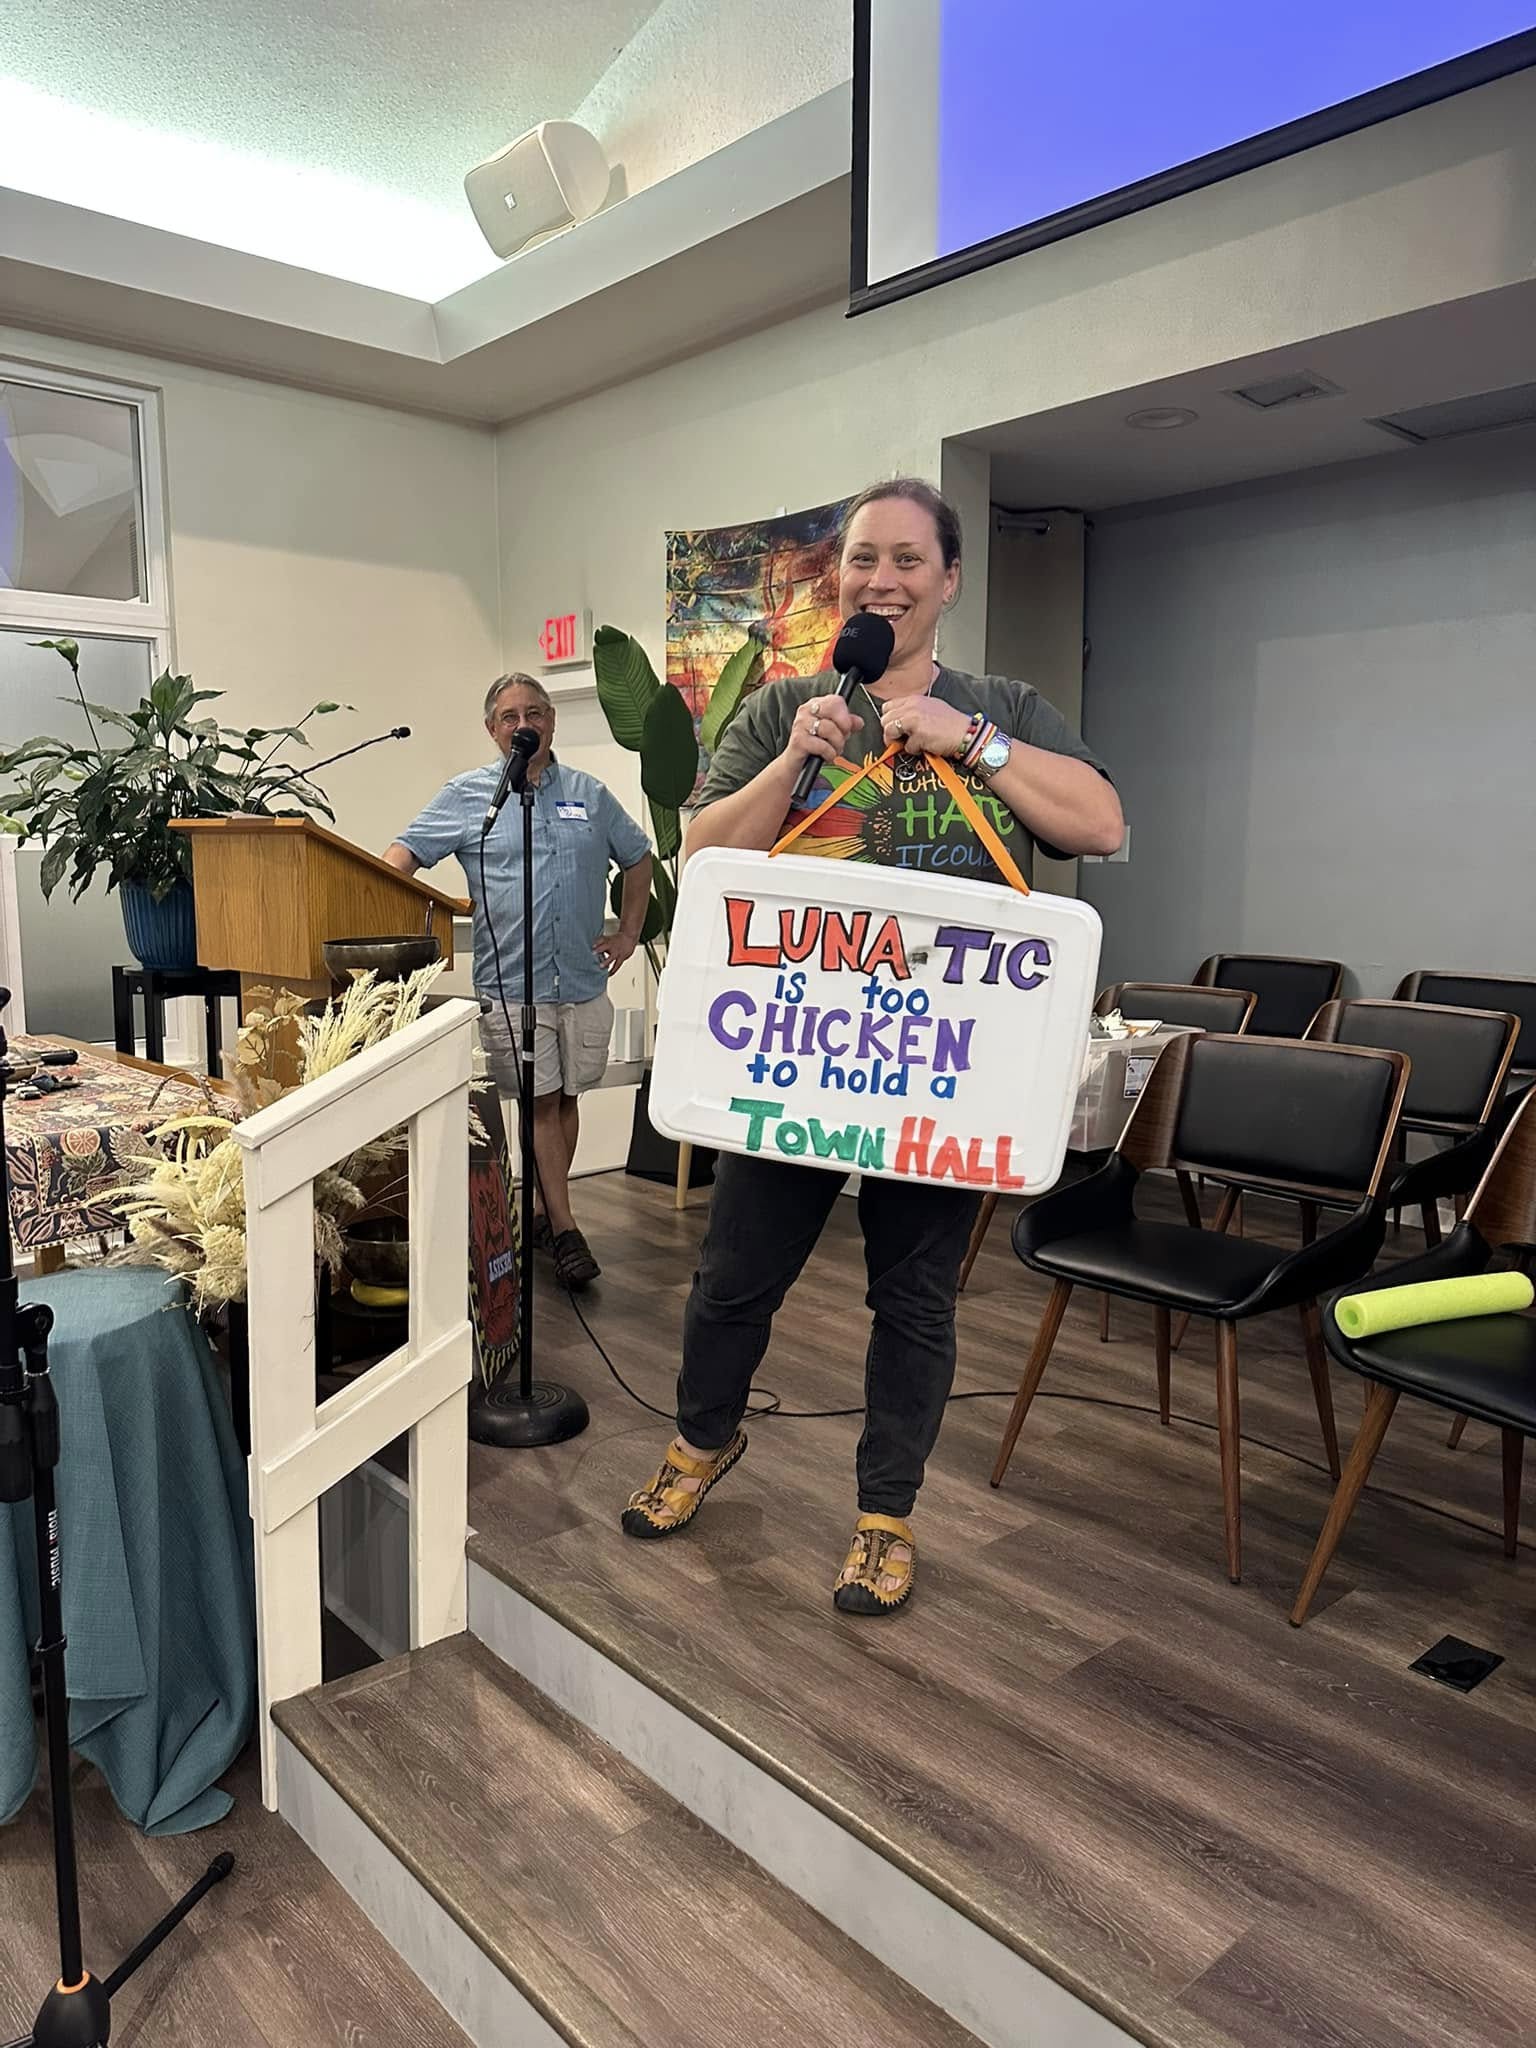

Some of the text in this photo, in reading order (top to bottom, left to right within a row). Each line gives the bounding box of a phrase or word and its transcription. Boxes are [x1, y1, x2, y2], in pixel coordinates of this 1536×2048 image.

[545, 614, 576, 660] EXIT
[957, 774, 992, 793] YO
[896, 794, 1015, 840] HATE
[931, 844, 1011, 867] COUL
[774, 963, 930, 1017] is too
[708, 990, 976, 1072] CHICKEN
[746, 1053, 957, 1099] to hold a
[729, 1097, 1026, 1189] TOWN HALL
